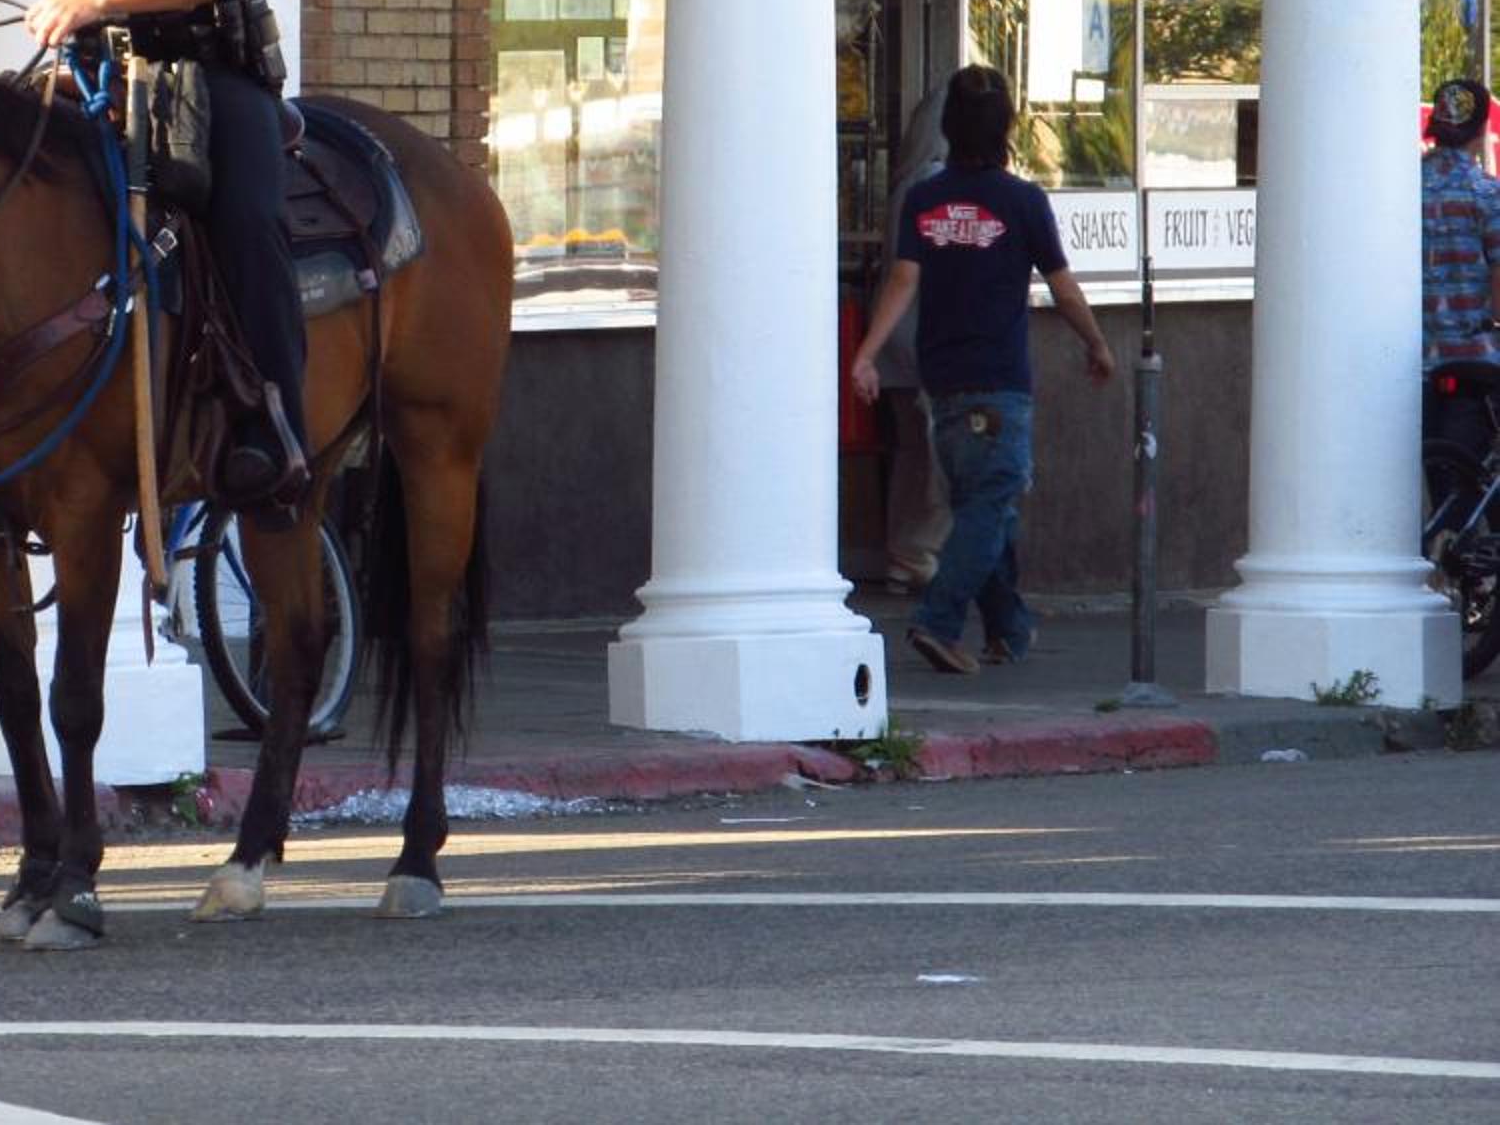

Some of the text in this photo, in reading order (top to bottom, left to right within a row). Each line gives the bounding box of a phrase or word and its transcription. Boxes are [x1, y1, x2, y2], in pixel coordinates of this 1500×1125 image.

[1069, 209, 1128, 251] SHAKES
[1164, 208, 1209, 249] FRUIT
[1226, 208, 1255, 247] VEG
